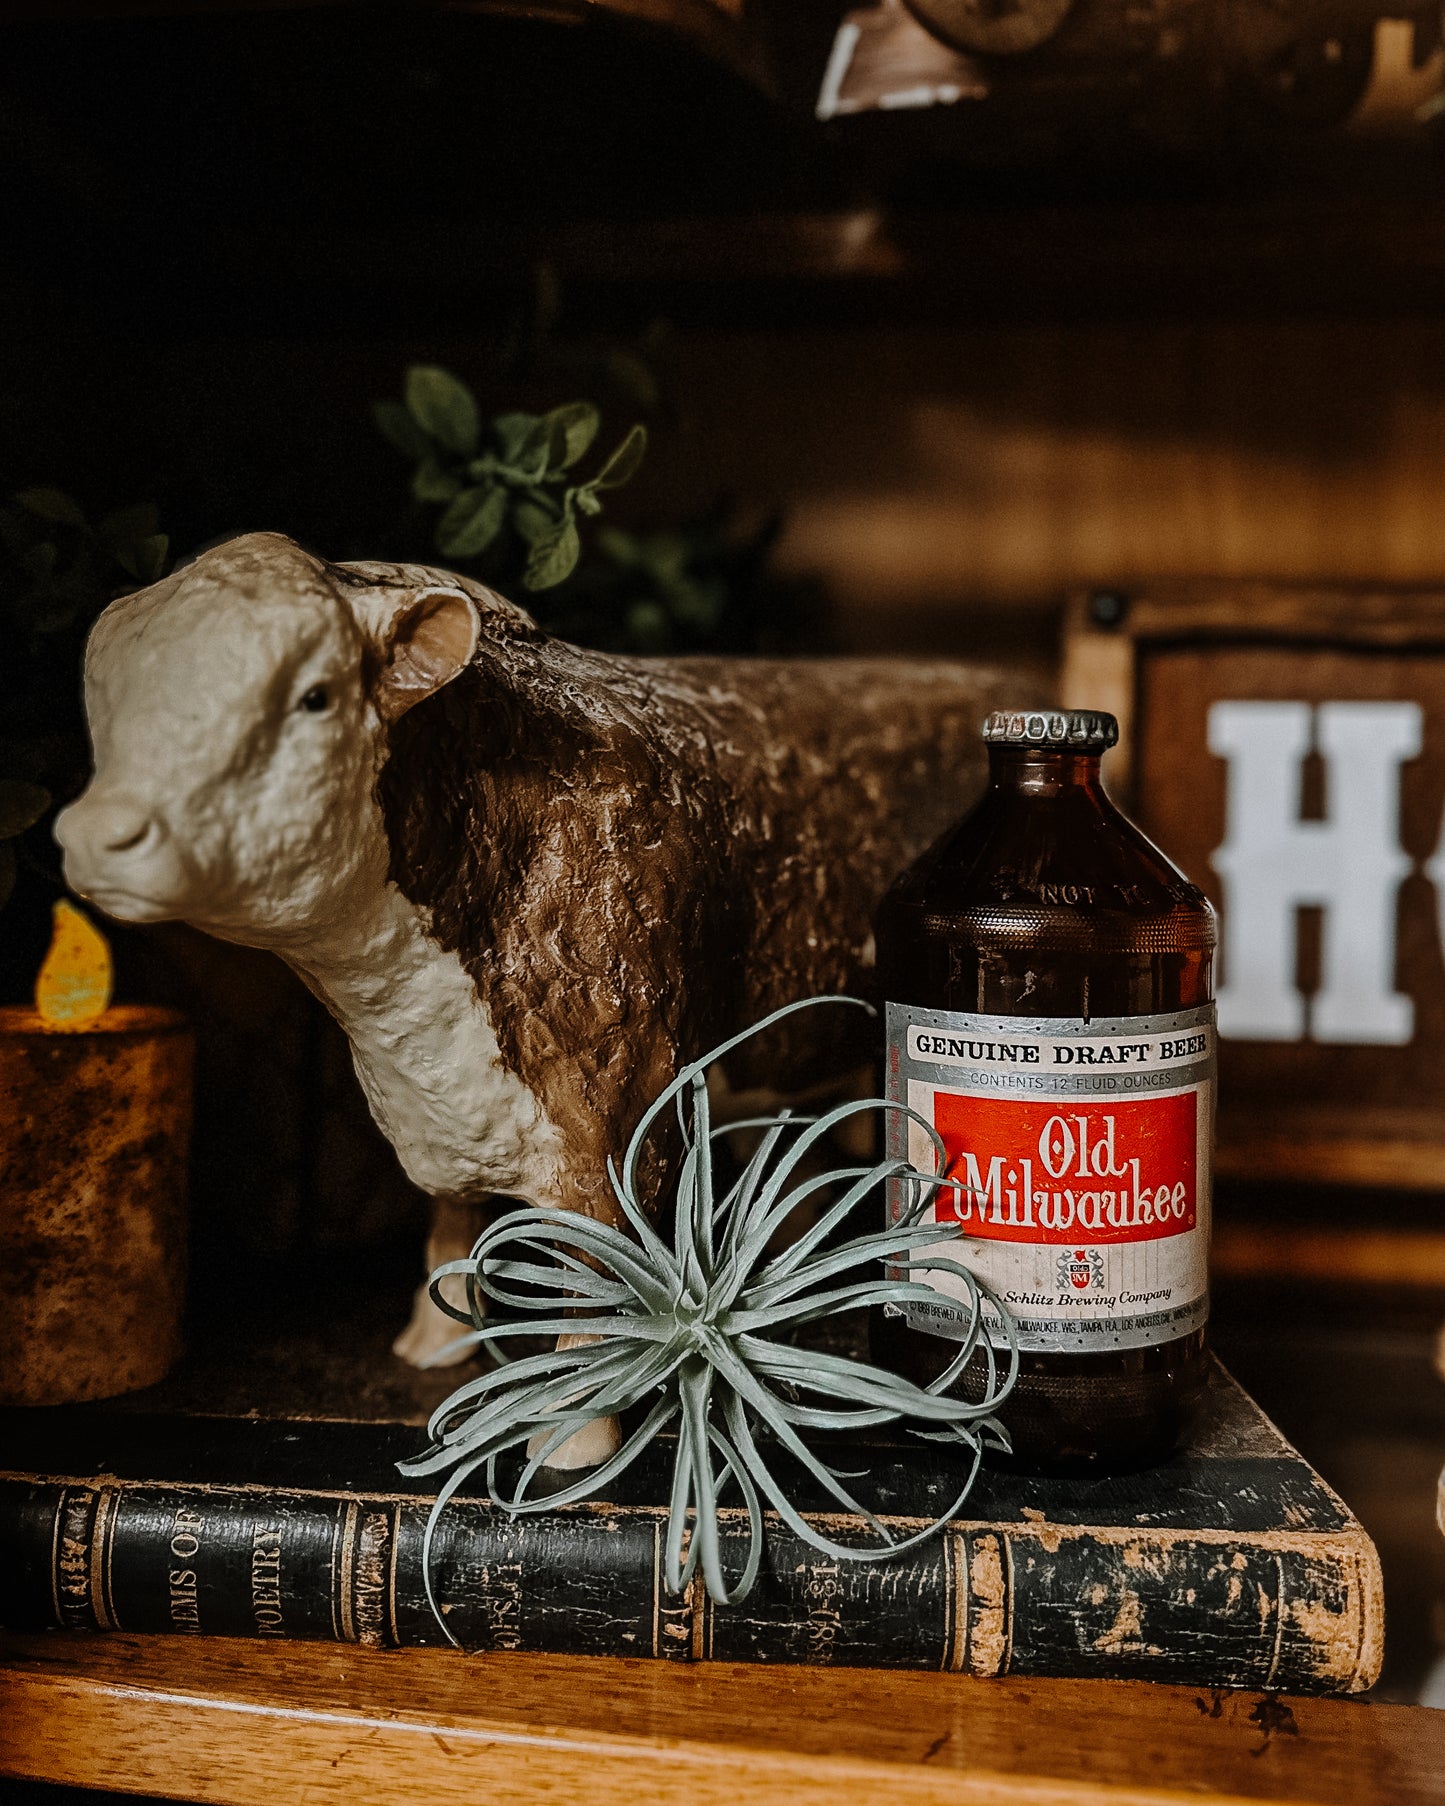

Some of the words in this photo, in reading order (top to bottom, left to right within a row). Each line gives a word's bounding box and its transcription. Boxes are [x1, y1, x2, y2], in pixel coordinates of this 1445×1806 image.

[1207, 700, 1445, 1047] H
[916, 1034, 1040, 1063] GENUINE
[1053, 1044, 1150, 1065] DRAFT
[1159, 1033, 1207, 1060] BEER
[970, 1072, 1044, 1089] CONTENTS
[1051, 1077, 1068, 1090] 12
[1076, 1076, 1116, 1090] FLUID
[1124, 1072, 1172, 1088] OUNCES
[1038, 1115, 1128, 1179] Old
[952, 1152, 1188, 1230] Milwaukee
[1004, 1291, 1054, 1306] Schlitz
[1056, 1293, 1116, 1309] Brewing
[1119, 1287, 1172, 1305] Company
[171, 1508, 205, 1558] OF
[252, 1522, 285, 1635] POETRY
